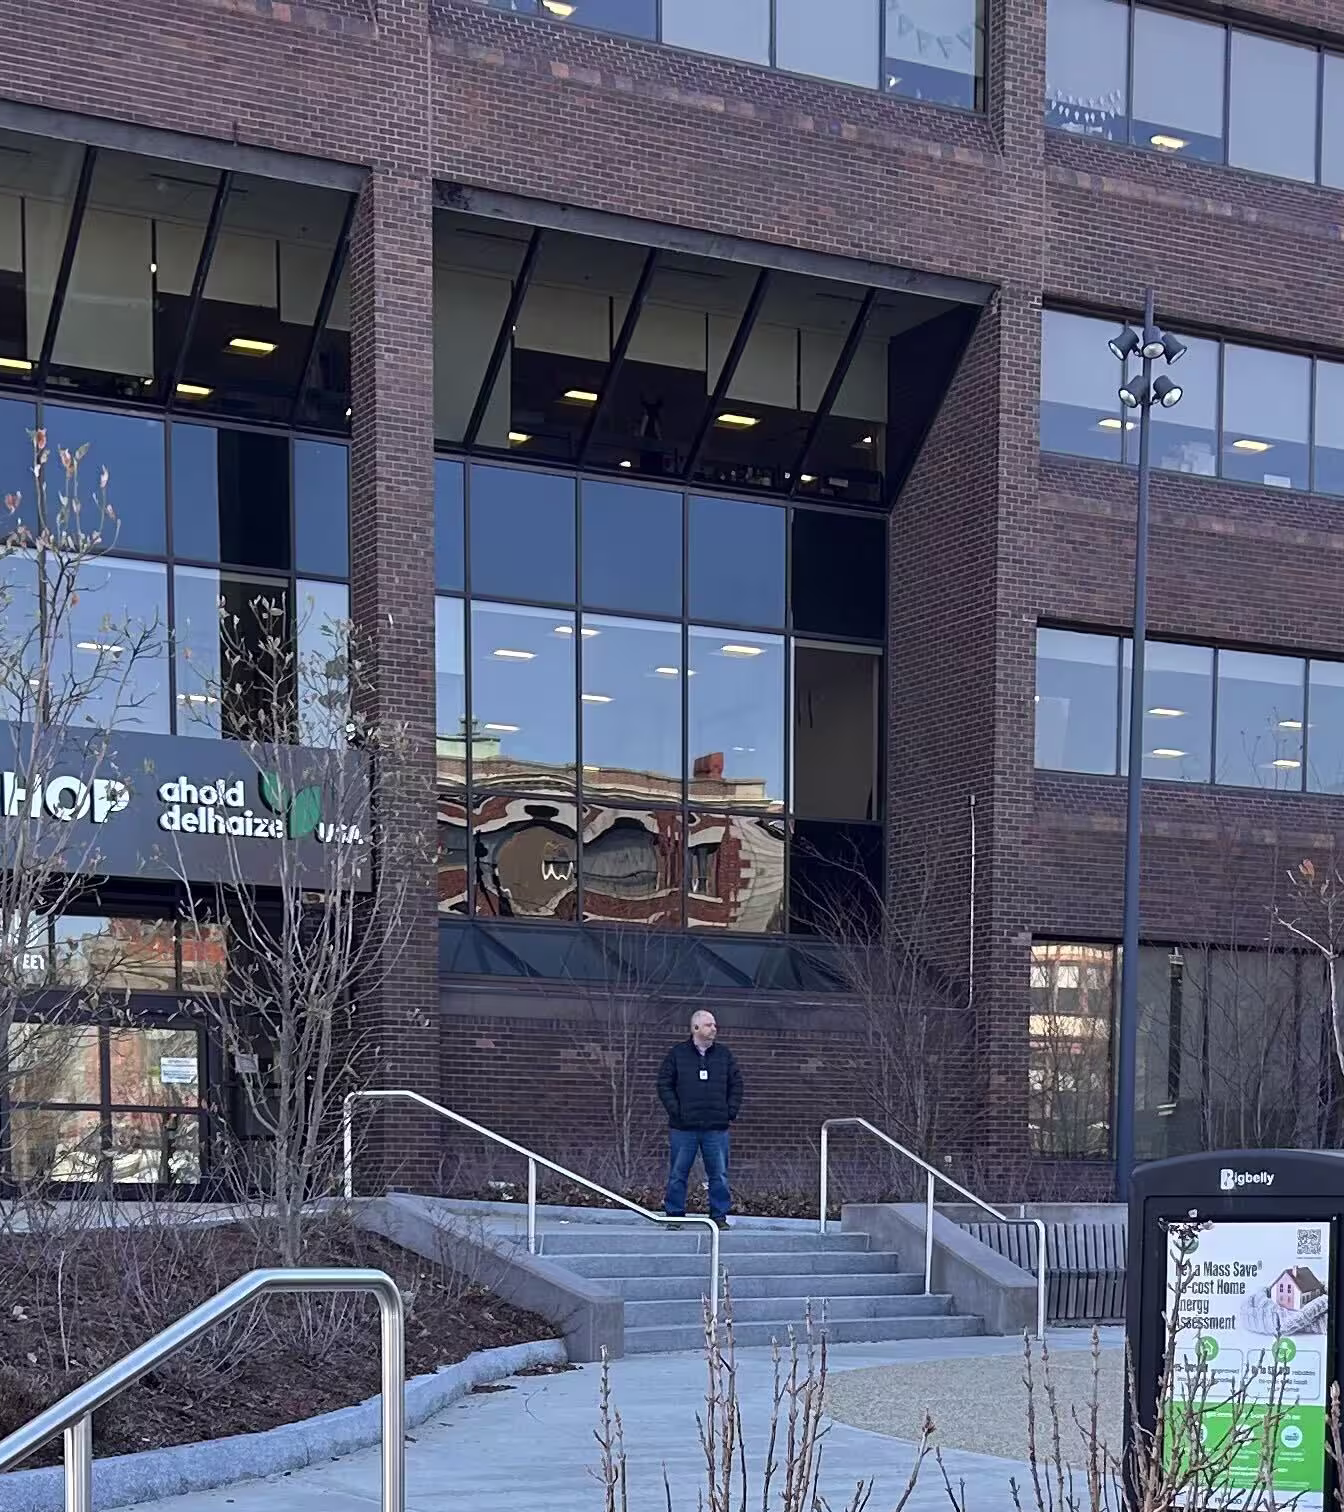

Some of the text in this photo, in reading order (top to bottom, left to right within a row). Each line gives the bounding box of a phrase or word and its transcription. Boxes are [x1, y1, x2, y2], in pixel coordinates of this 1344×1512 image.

[160, 776, 244, 807] ahold
[160, 804, 283, 839] delhaize
[1220, 1168, 1274, 1190] Bigbelly
[1203, 1261, 1230, 1277] Mass
[1217, 1279, 1246, 1294] Home
[1176, 1299, 1209, 1314] nergy
